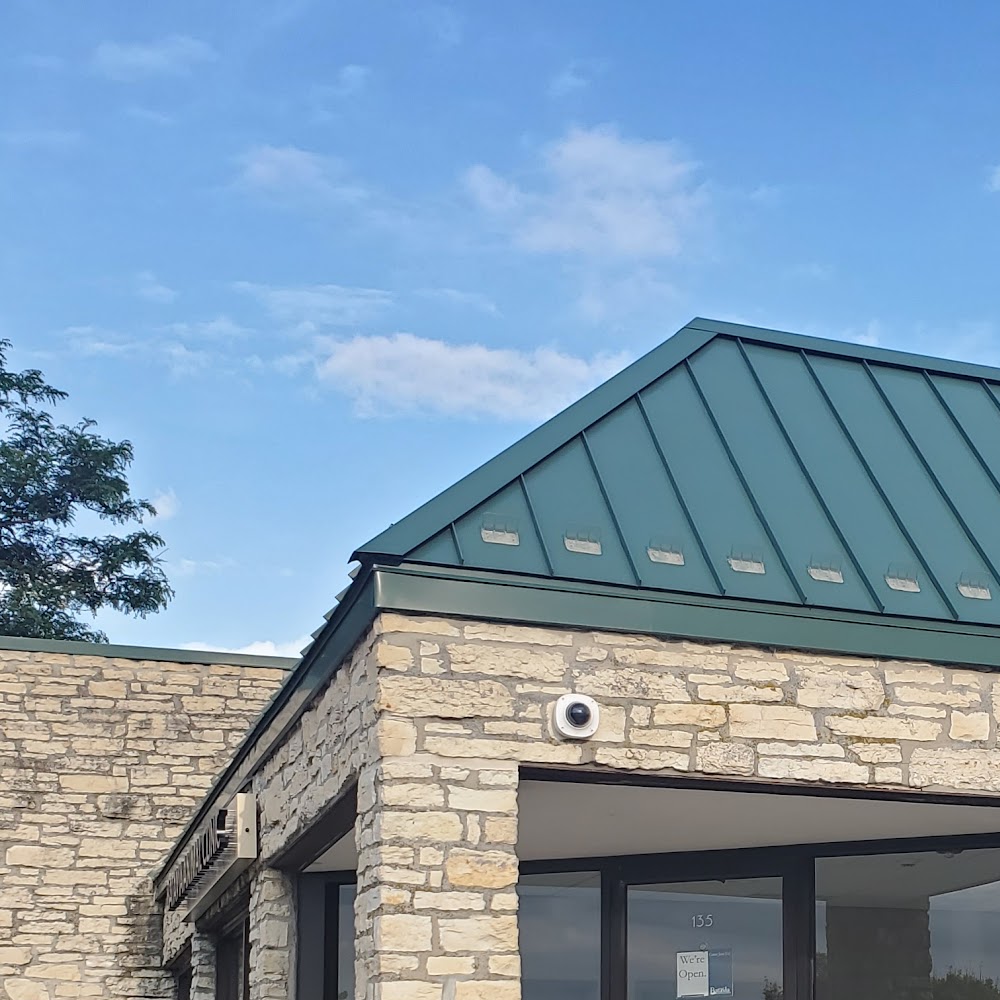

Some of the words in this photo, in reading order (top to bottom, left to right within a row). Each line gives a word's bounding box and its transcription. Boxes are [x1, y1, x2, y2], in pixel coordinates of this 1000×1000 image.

[691, 914, 713, 928] 135
[680, 955, 705, 964] We're
[679, 969, 707, 980] Open.
